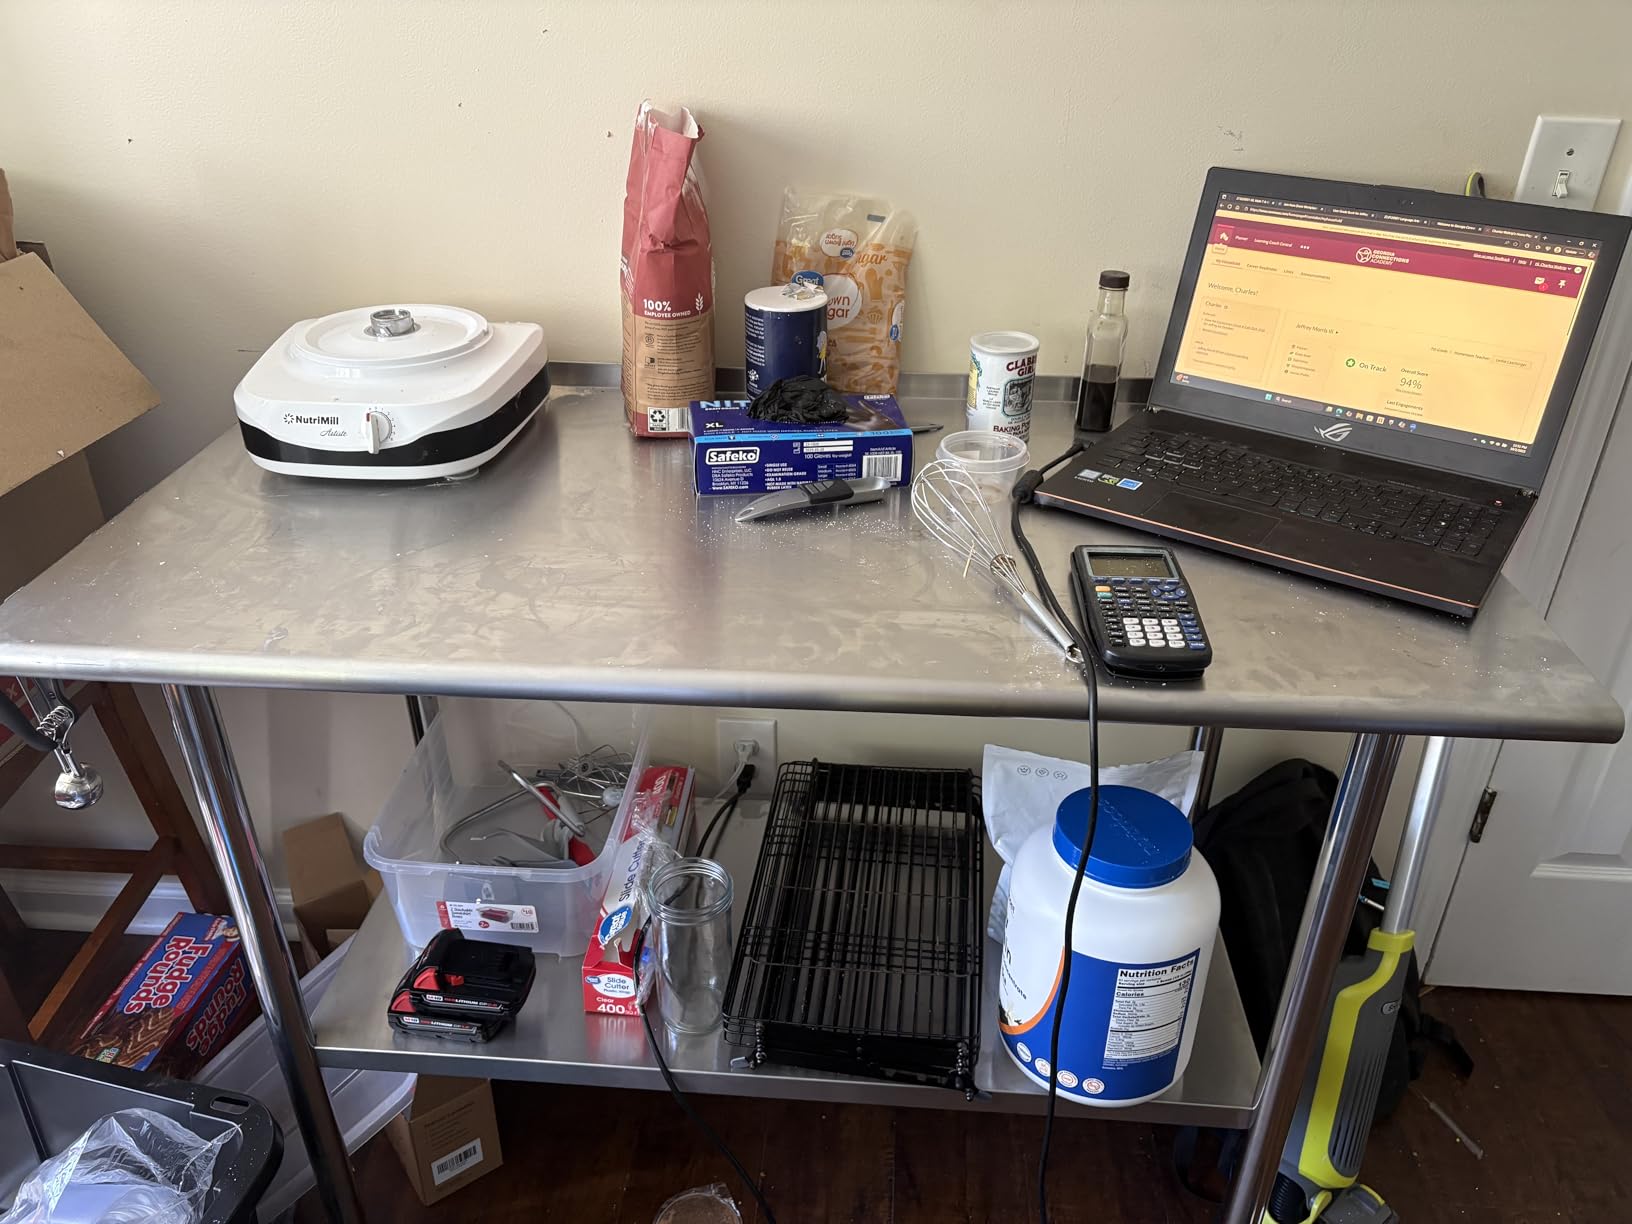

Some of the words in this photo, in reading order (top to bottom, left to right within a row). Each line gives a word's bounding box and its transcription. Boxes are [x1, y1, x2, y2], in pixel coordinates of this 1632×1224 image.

[1370, 258, 1394, 266] ACADEMY
[1371, 253, 1409, 264] CONNECTIONS
[1208, 282, 1234, 293] Welcome,
[1235, 285, 1259, 297] Charles!
[643, 299, 672, 312] 100%
[827, 295, 850, 306] own
[644, 310, 671, 318] EMPLOYEE
[671, 310, 691, 318] OWNED
[827, 307, 850, 320] gar
[1296, 323, 1312, 333] Jeffrey
[1312, 325, 1328, 334] Morris
[1006, 354, 1037, 372] CLABB
[1359, 361, 1369, 369] On
[1370, 363, 1387, 373] Track
[1401, 367, 1416, 375] Overall
[1399, 377, 1422, 390] 94%
[295, 415, 339, 425] NutriMill
[993, 425, 1020, 433] BAKING
[709, 451, 756, 462] Safeko
[618, 873, 636, 903] Slide
[604, 910, 621, 945] Great
[124, 935, 195, 1015] Rounds
[1120, 969, 1167, 978] Nutrition
[1170, 959, 1194, 973] Facts
[151, 943, 212, 1009] Fudge
[186, 958, 246, 1050] Rounds
[597, 1003, 625, 1014] 400
[199, 983, 247, 1056] Fudge
